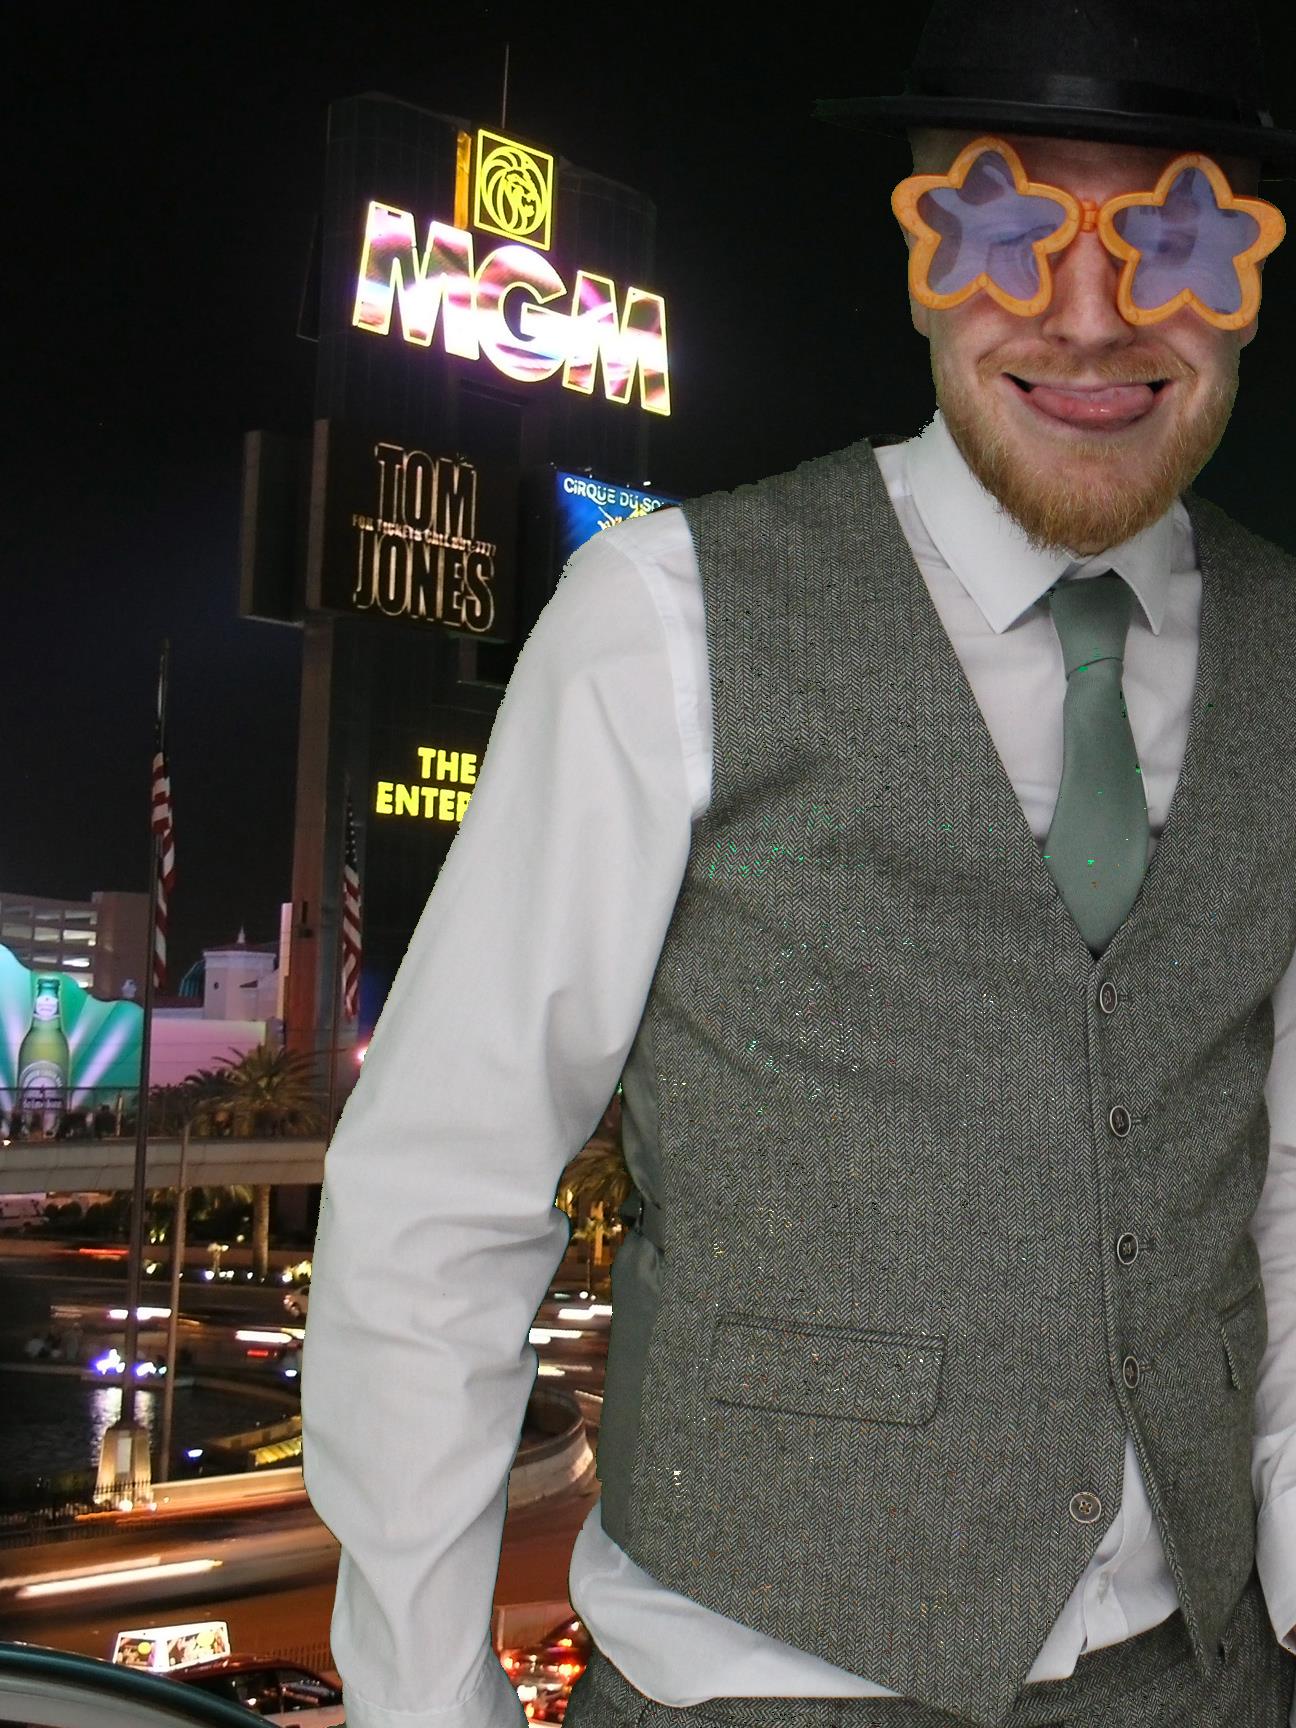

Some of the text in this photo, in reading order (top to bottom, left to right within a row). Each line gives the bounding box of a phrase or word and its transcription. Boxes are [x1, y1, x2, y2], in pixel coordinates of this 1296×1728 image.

[351, 200, 672, 417] MGM
[375, 442, 478, 539] TOM
[352, 530, 496, 633] JONES
[418, 746, 478, 785] THE
